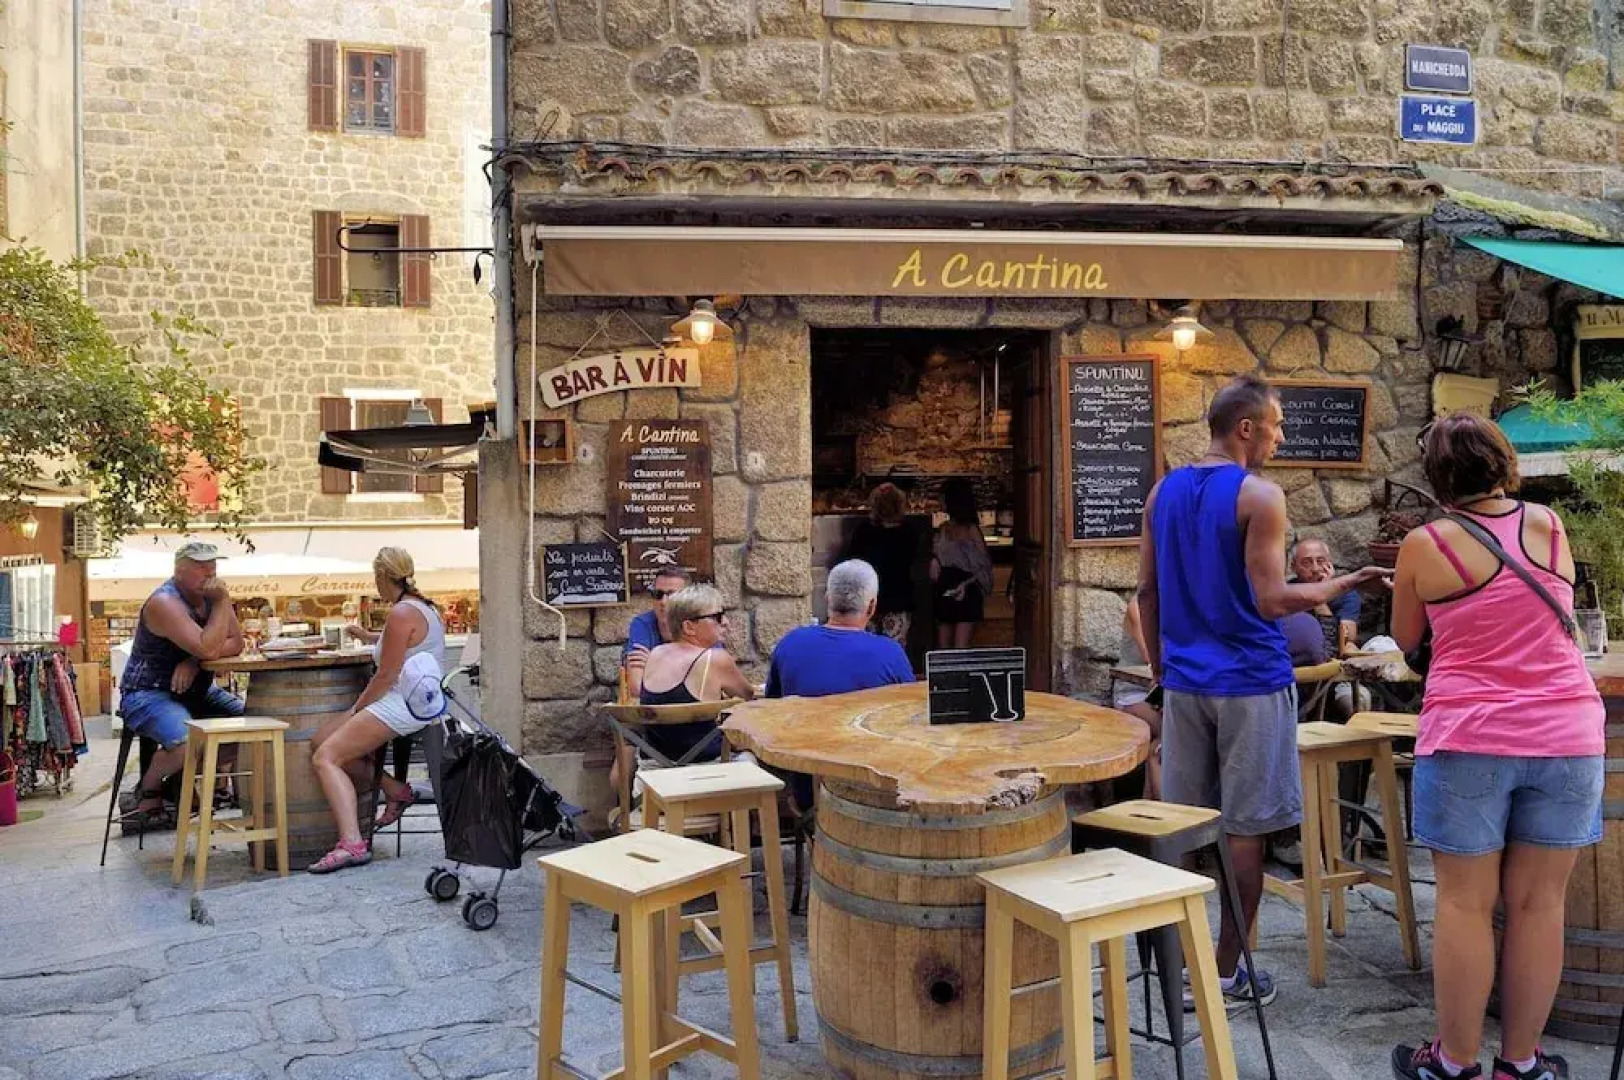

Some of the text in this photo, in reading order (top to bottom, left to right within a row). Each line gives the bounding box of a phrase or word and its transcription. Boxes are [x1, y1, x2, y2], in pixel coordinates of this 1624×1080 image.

[1420, 103, 1456, 118] PLACE
[1412, 121, 1465, 134] DU MAGGIU
[892, 249, 1108, 290] A Cantina
[551, 366, 608, 400] BAR
[635, 353, 687, 383] VIN
[1075, 365, 1143, 381] SPUNTINU
[620, 424, 700, 444] A Cantina
[634, 469, 686, 479] Charcuterie
[618, 478, 701, 492] Fromages fermiers
[624, 503, 645, 513] Vins
[646, 504, 675, 513] corses
[570, 548, 615, 567] produits
